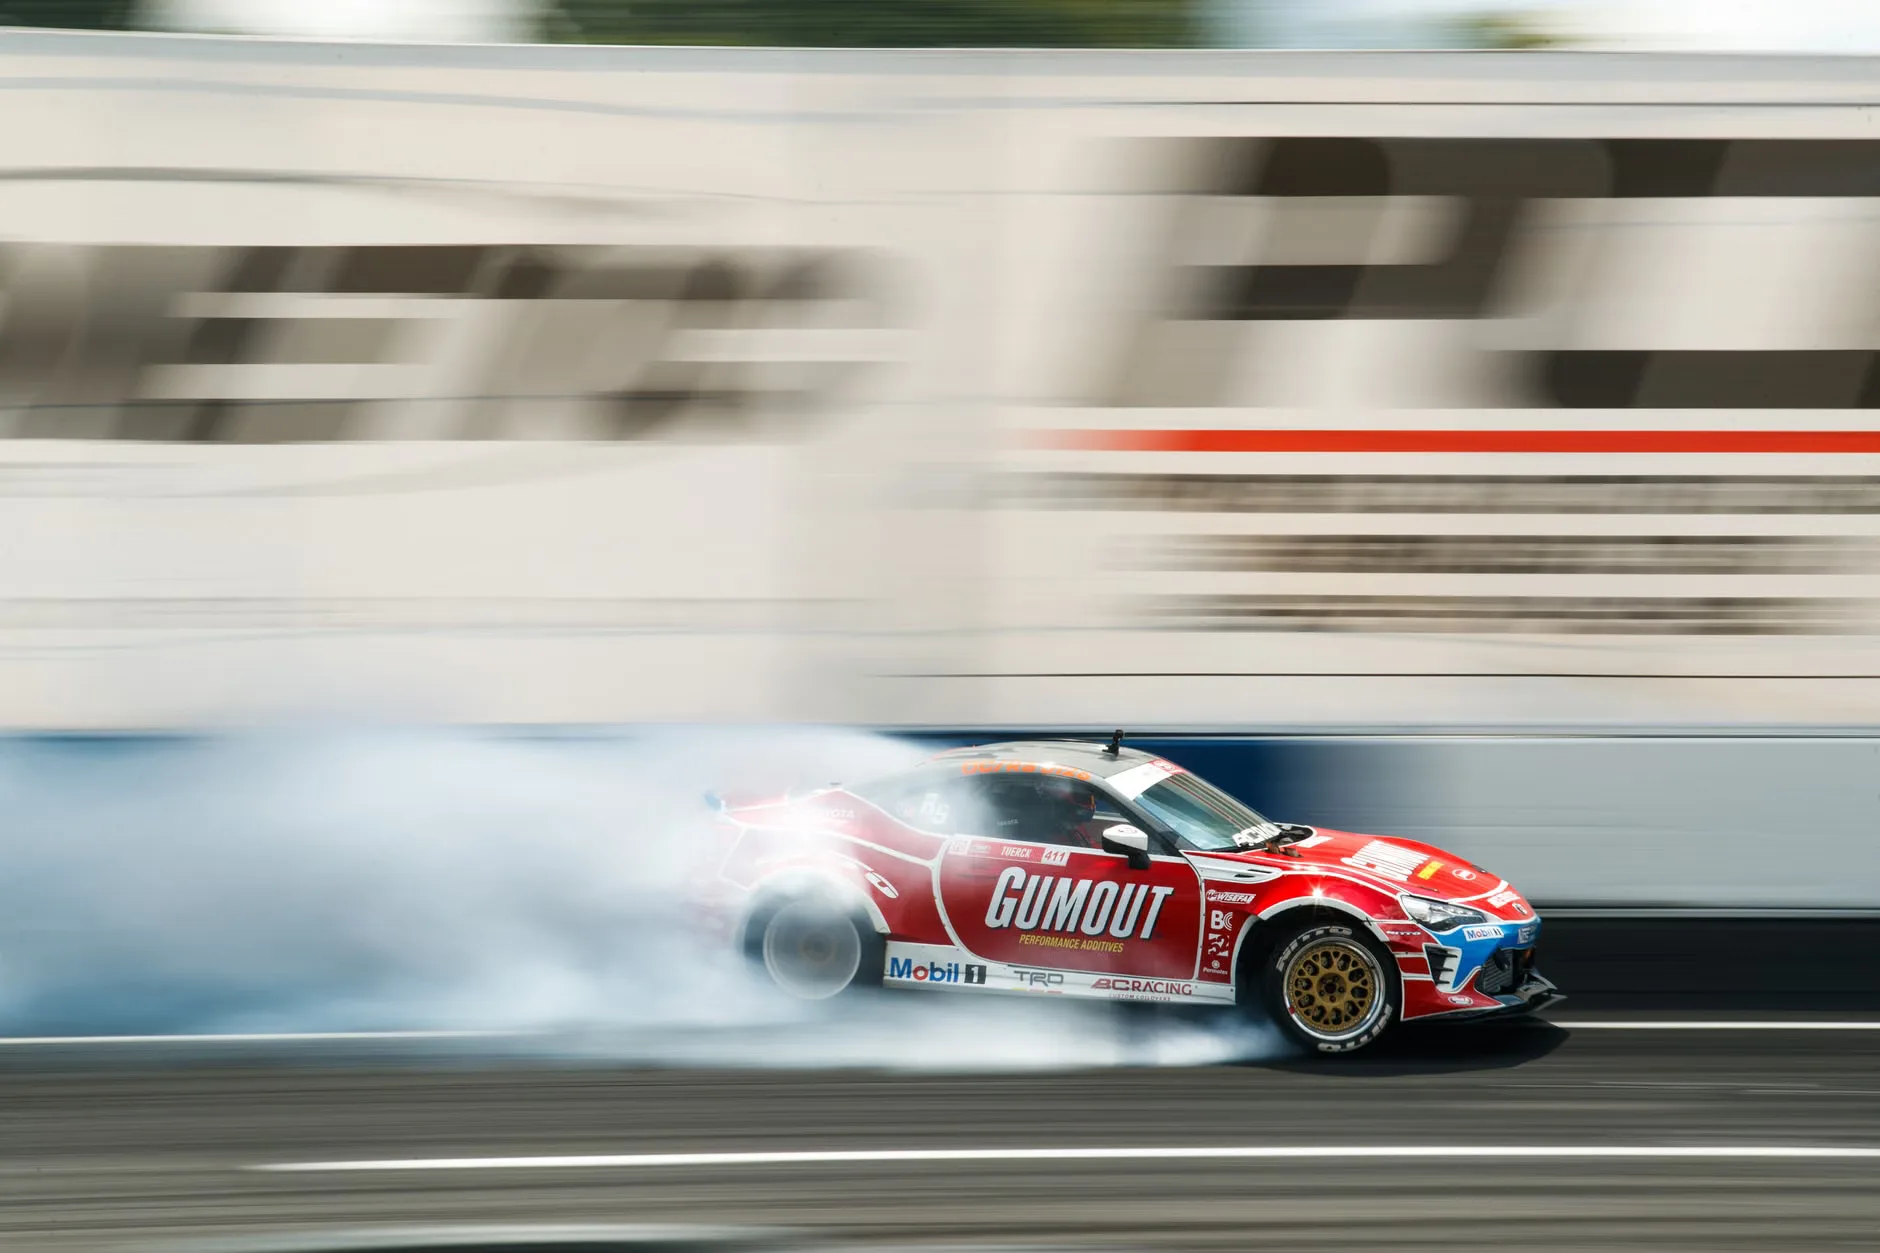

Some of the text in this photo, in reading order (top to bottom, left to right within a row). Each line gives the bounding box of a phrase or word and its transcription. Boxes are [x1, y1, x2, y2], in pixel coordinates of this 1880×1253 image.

[1000, 846, 1032, 859] TUERCK
[1044, 848, 1066, 862] 411
[984, 866, 1175, 940] GUMOUT
[1466, 926, 1494, 940] Mobil
[1019, 934, 1124, 953] PERFORMANCE ADDITIVES
[889, 957, 959, 983] Mobil
[1014, 970, 1064, 987] TRD
